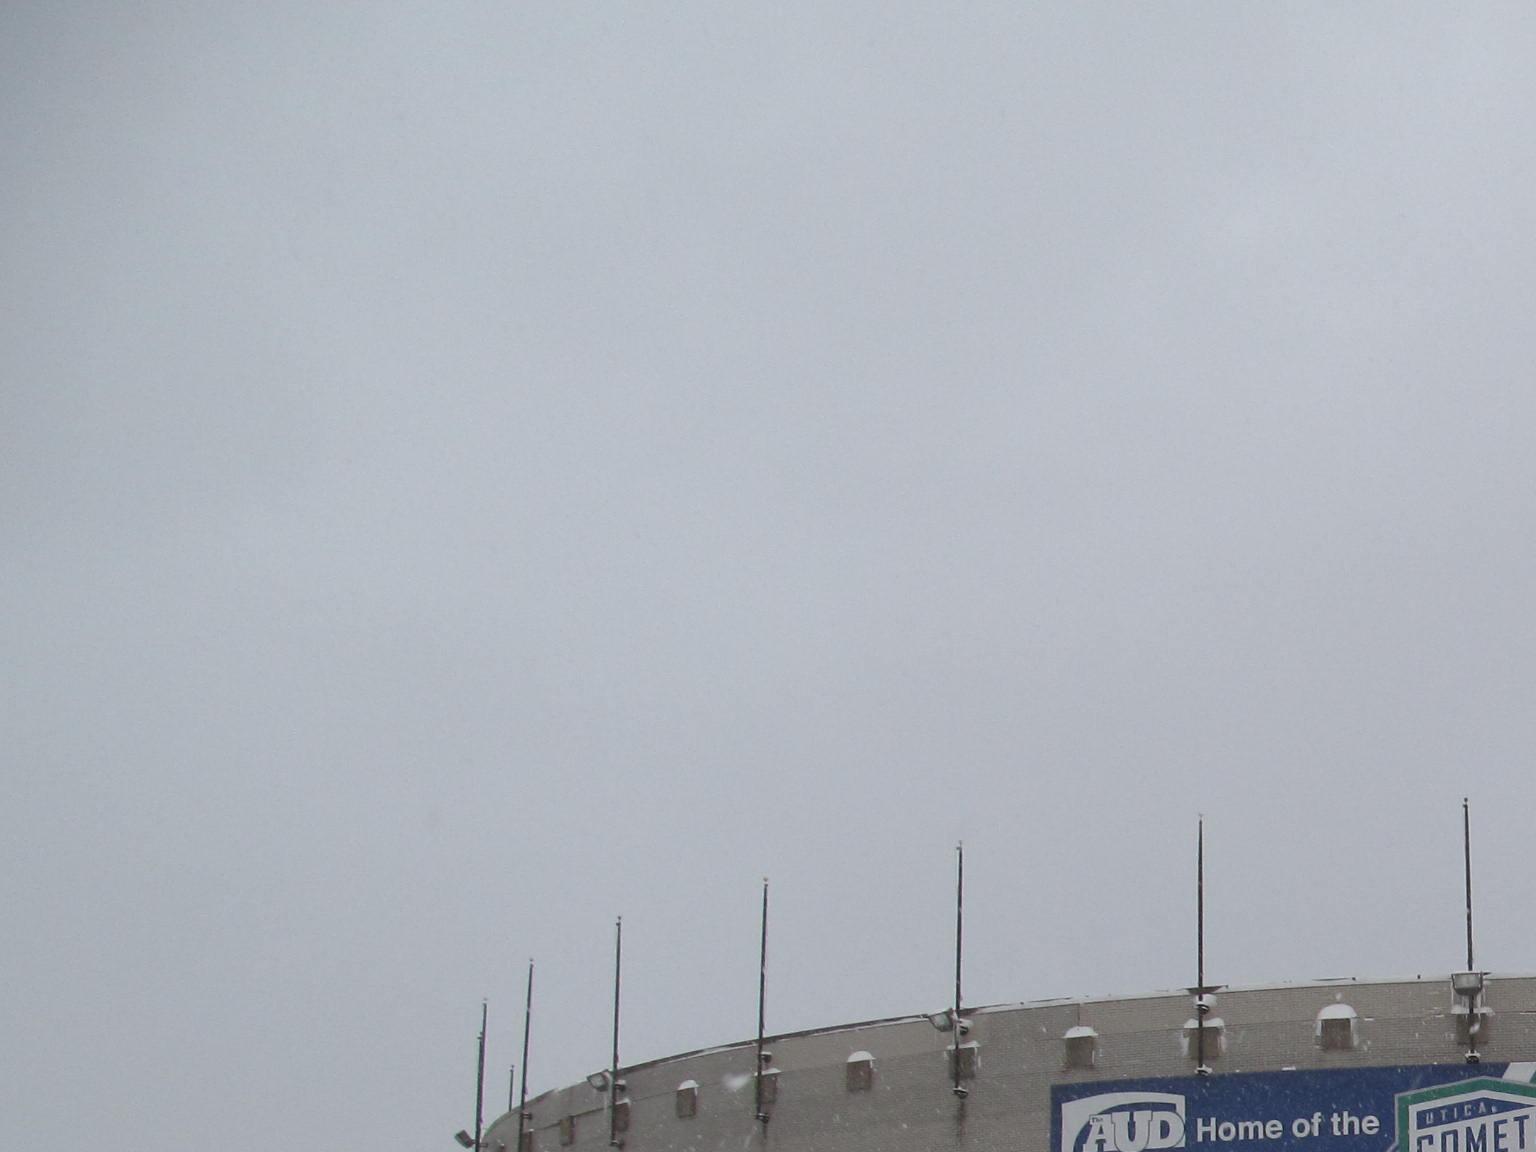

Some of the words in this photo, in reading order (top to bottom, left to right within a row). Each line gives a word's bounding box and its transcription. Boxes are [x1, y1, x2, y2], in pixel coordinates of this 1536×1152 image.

[1196, 1117, 1284, 1142] Home
[1292, 1112, 1322, 1138] of
[1331, 1111, 1380, 1136] the
[1425, 1101, 1487, 1125] UTICA
